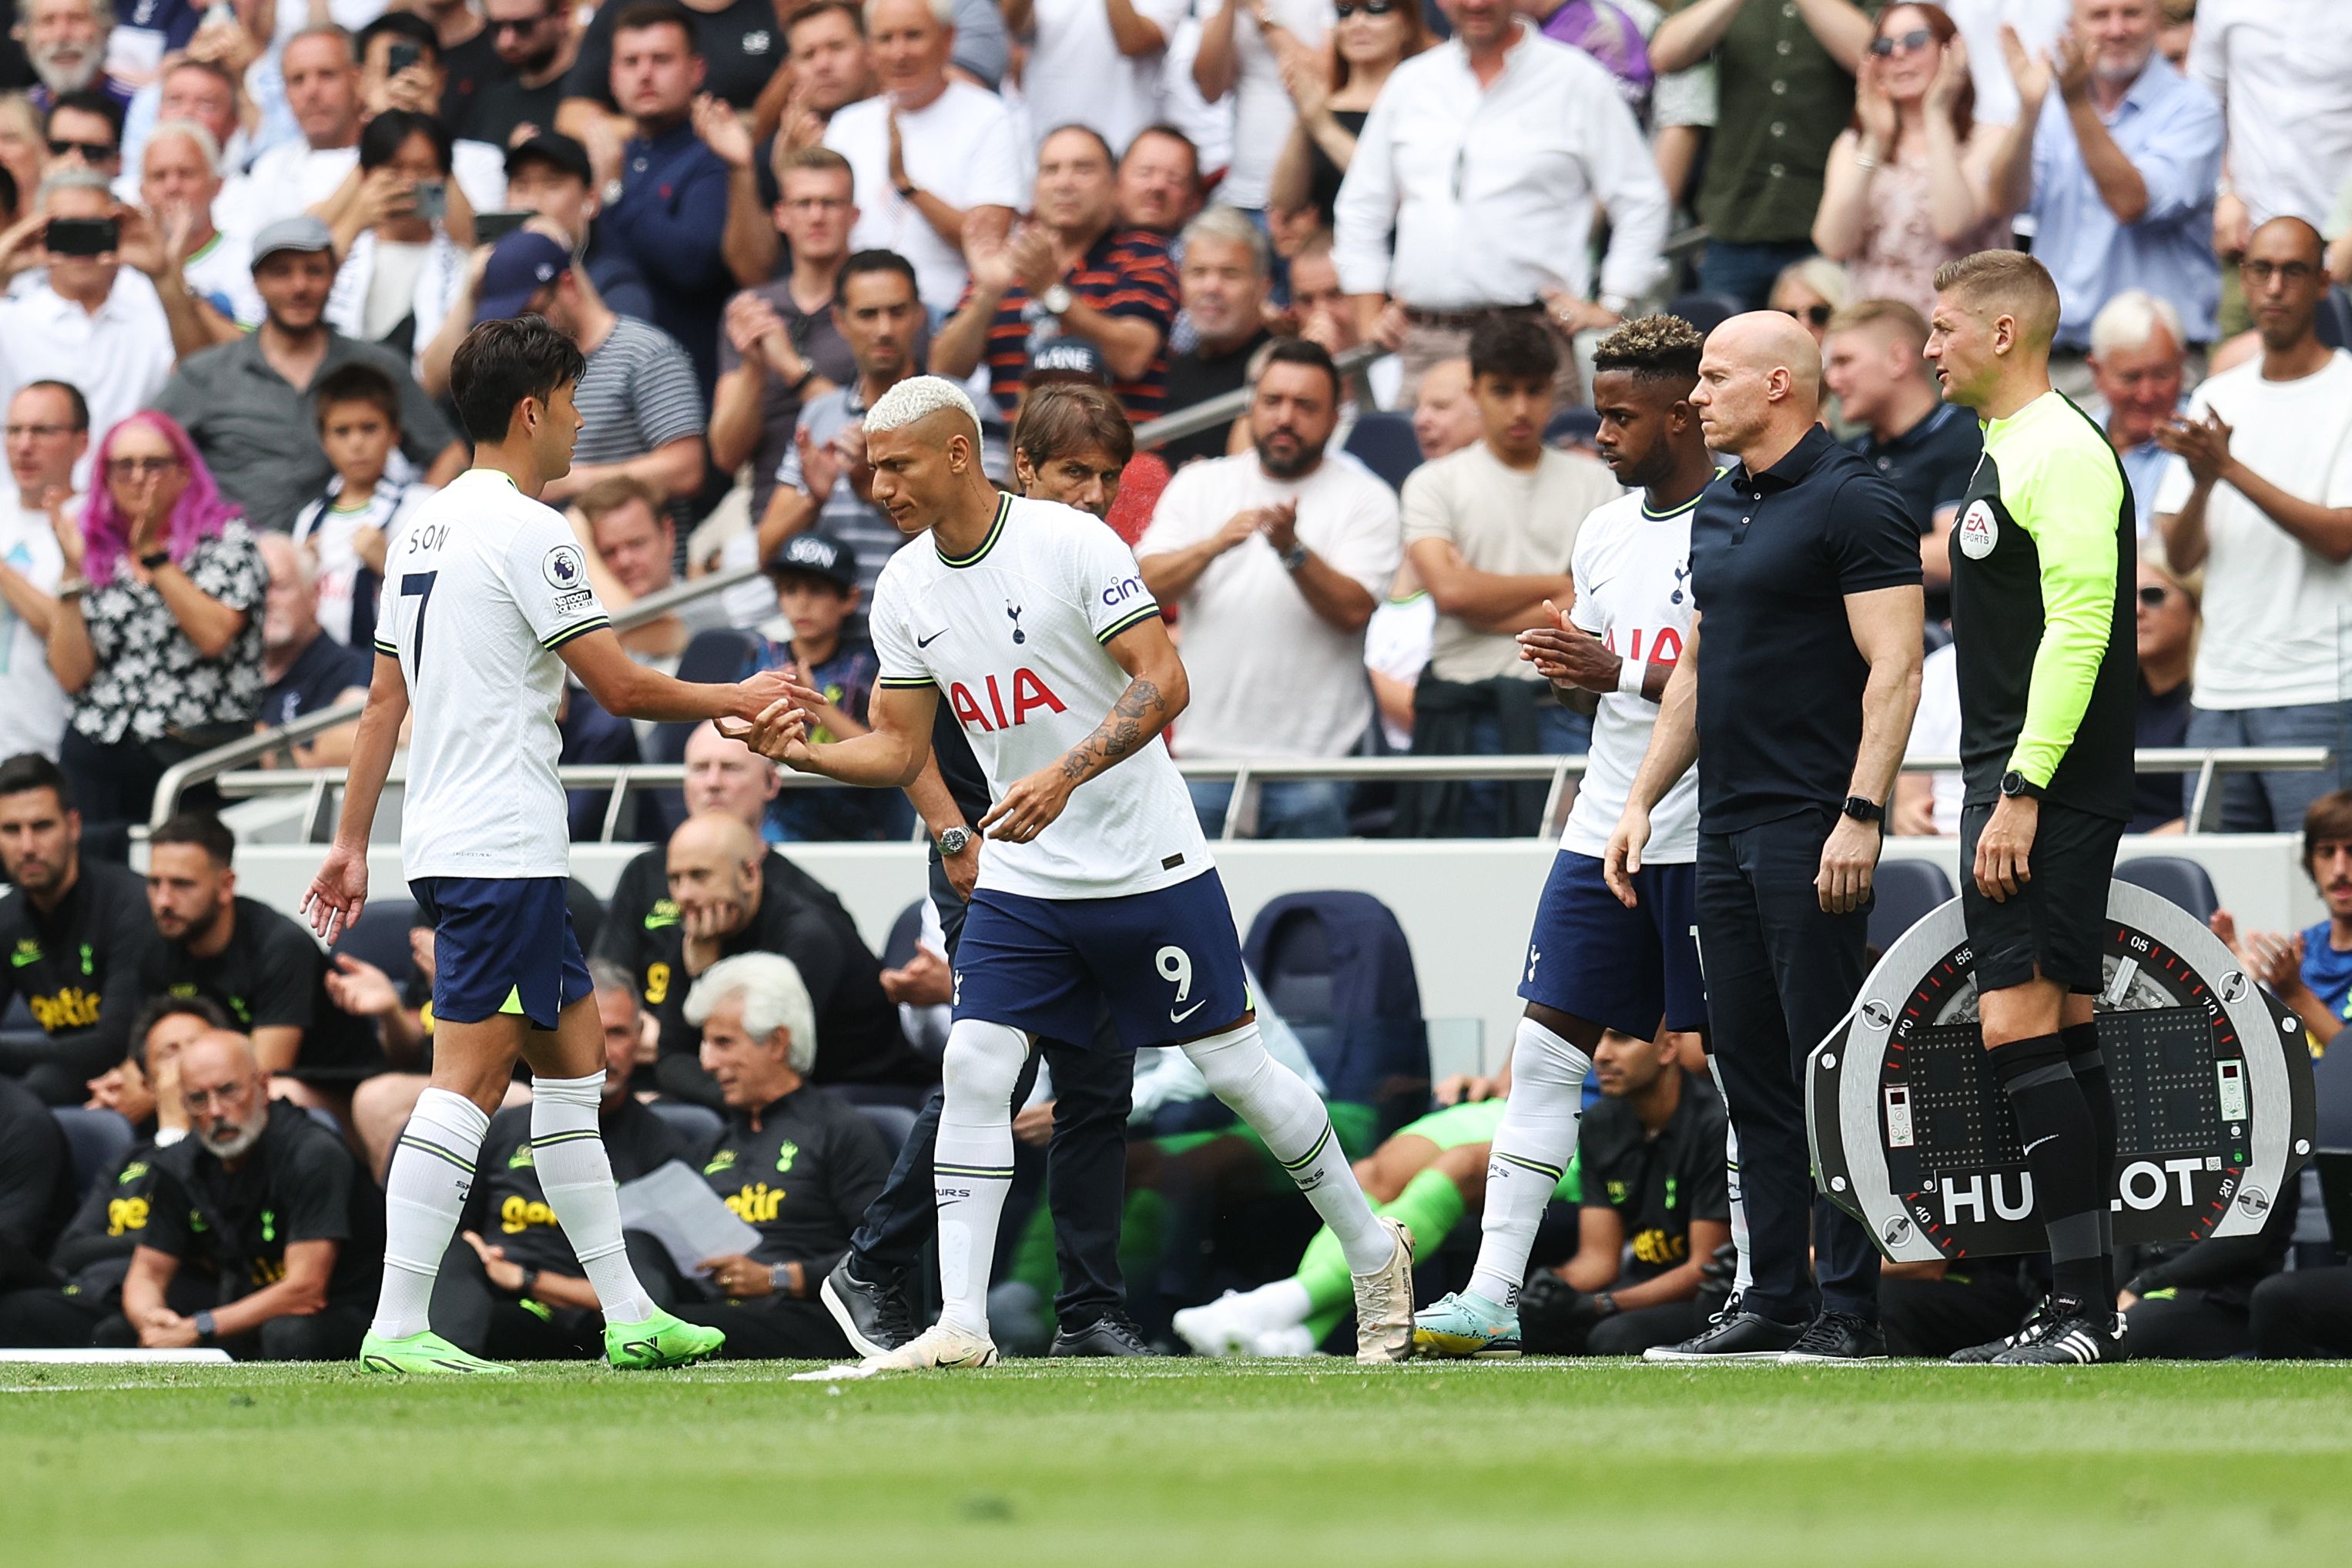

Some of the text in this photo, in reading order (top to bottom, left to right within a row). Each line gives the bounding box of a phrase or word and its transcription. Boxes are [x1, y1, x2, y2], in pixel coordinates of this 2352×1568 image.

[1965, 513, 1988, 534] EA
[409, 524, 451, 554] SON
[1962, 531, 1989, 544] SPORTS
[1103, 575, 1141, 605] cin
[400, 570, 438, 685] 7
[950, 668, 1067, 732] AIA
[1955, 948, 1972, 965] 55
[2131, 936, 2149, 952] 05
[1156, 946, 1191, 1002] 9
[2203, 997, 2218, 1015] 10
[1942, 1158, 2203, 1225] HUOT
[2219, 1179, 2234, 1198] 20
[107, 1196, 152, 1237] ge
[1915, 1206, 1932, 1223] 40
